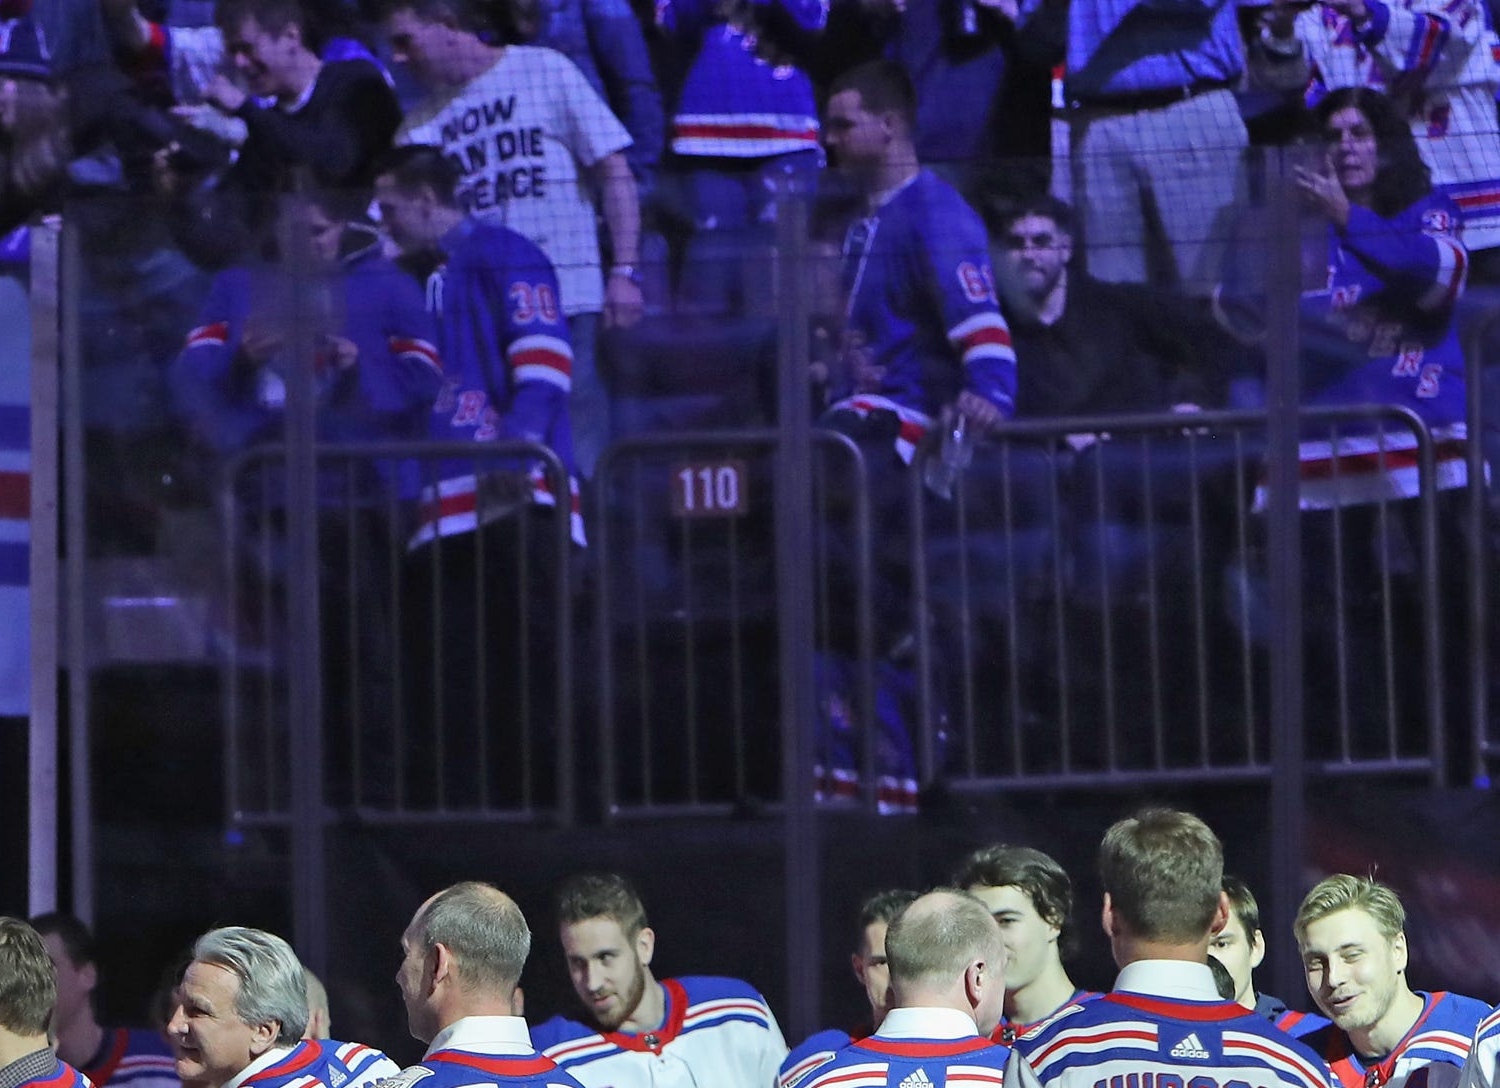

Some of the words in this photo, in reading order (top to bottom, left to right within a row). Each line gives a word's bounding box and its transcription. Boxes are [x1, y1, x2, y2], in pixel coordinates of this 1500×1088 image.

[443, 94, 516, 142] NOW
[496, 128, 544, 160] DIE
[509, 281, 558, 325] 30
[679, 467, 738, 509] 110
[1171, 1048, 1210, 1060] adidas
